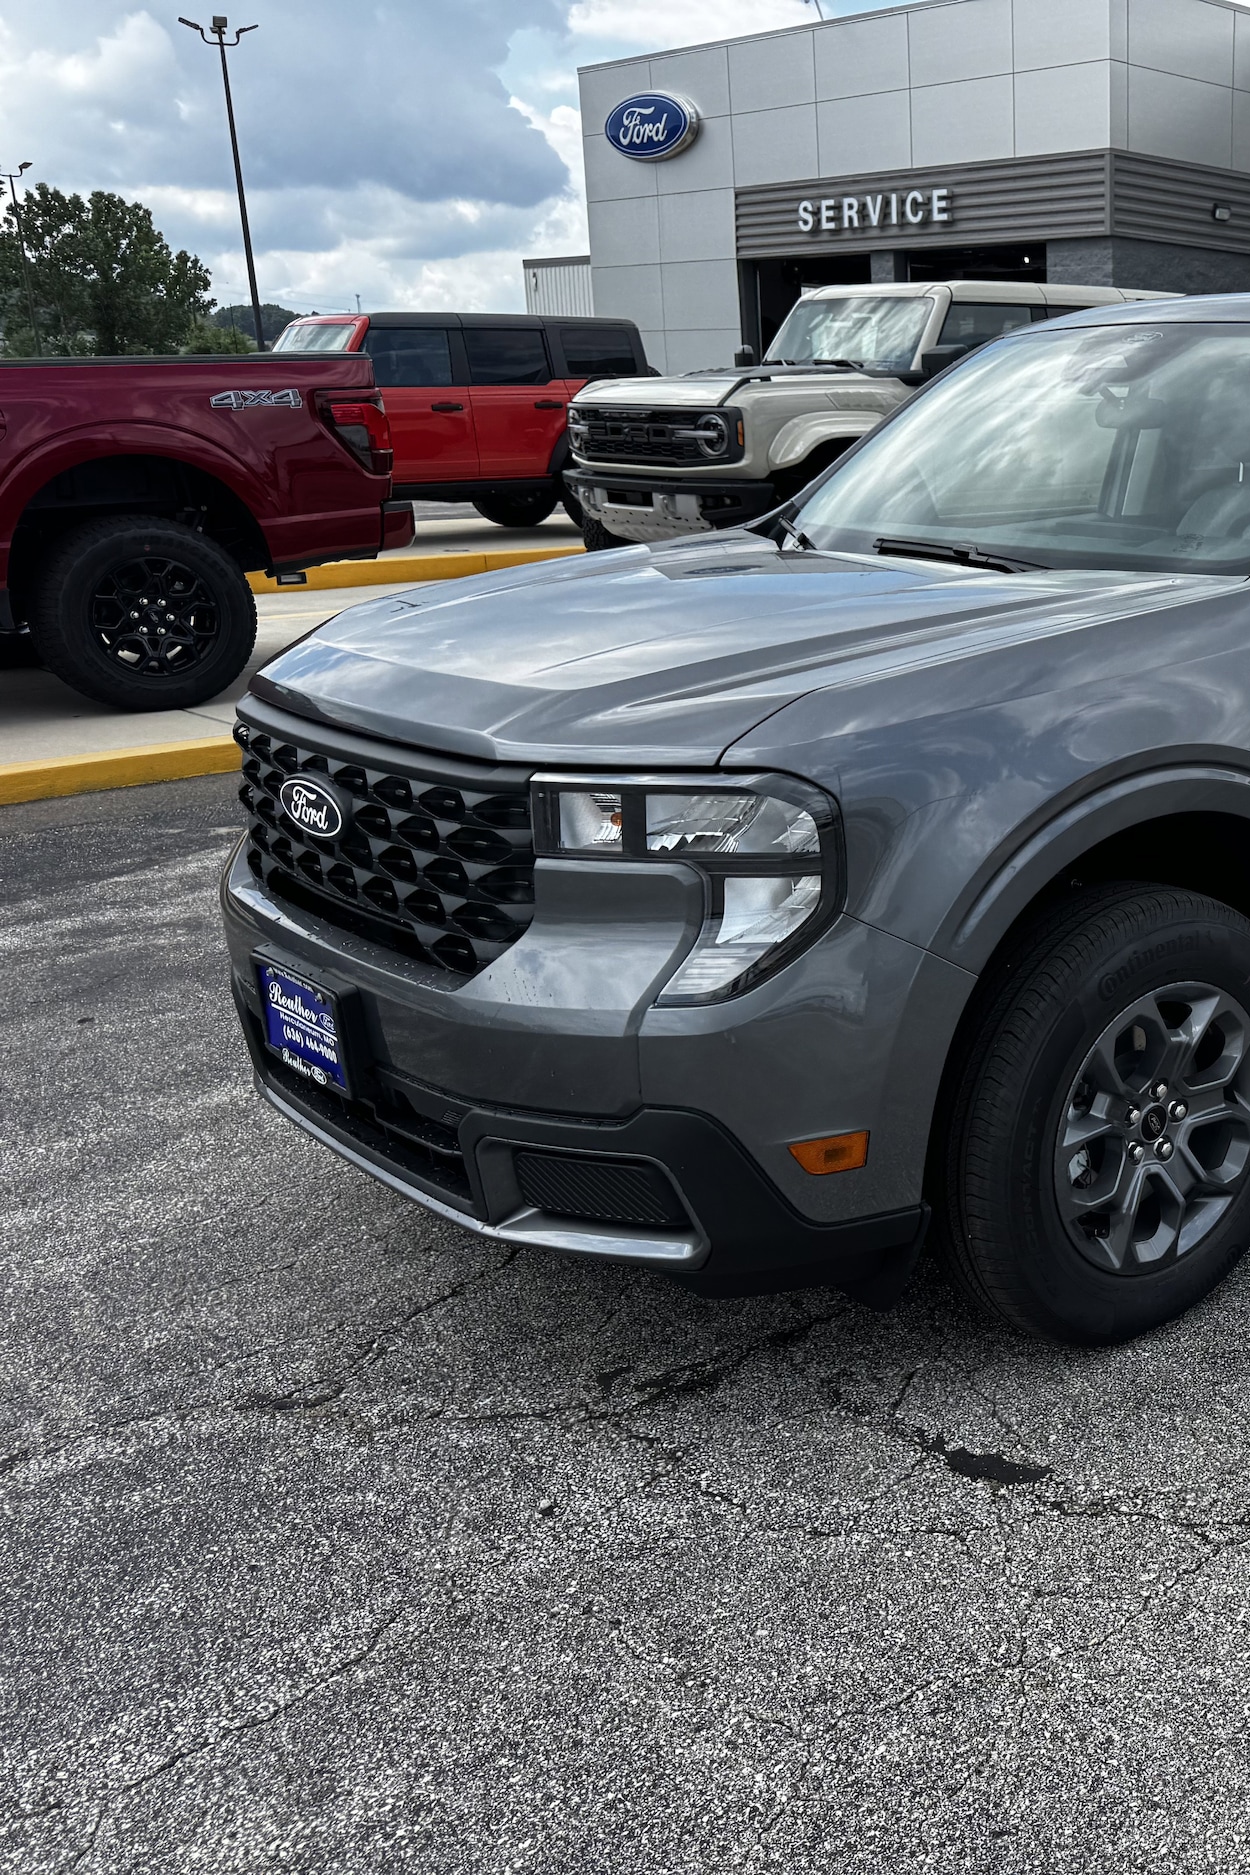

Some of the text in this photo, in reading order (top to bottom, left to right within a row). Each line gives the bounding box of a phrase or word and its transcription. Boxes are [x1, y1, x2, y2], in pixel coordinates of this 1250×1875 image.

[619, 106, 668, 146] Ford
[798, 188, 951, 233] SERVICE
[291, 784, 329, 832] Ford
[1098, 930, 1200, 1002] Continental
[268, 981, 318, 1023] Reuther
[282, 1024, 304, 1048] (636)
